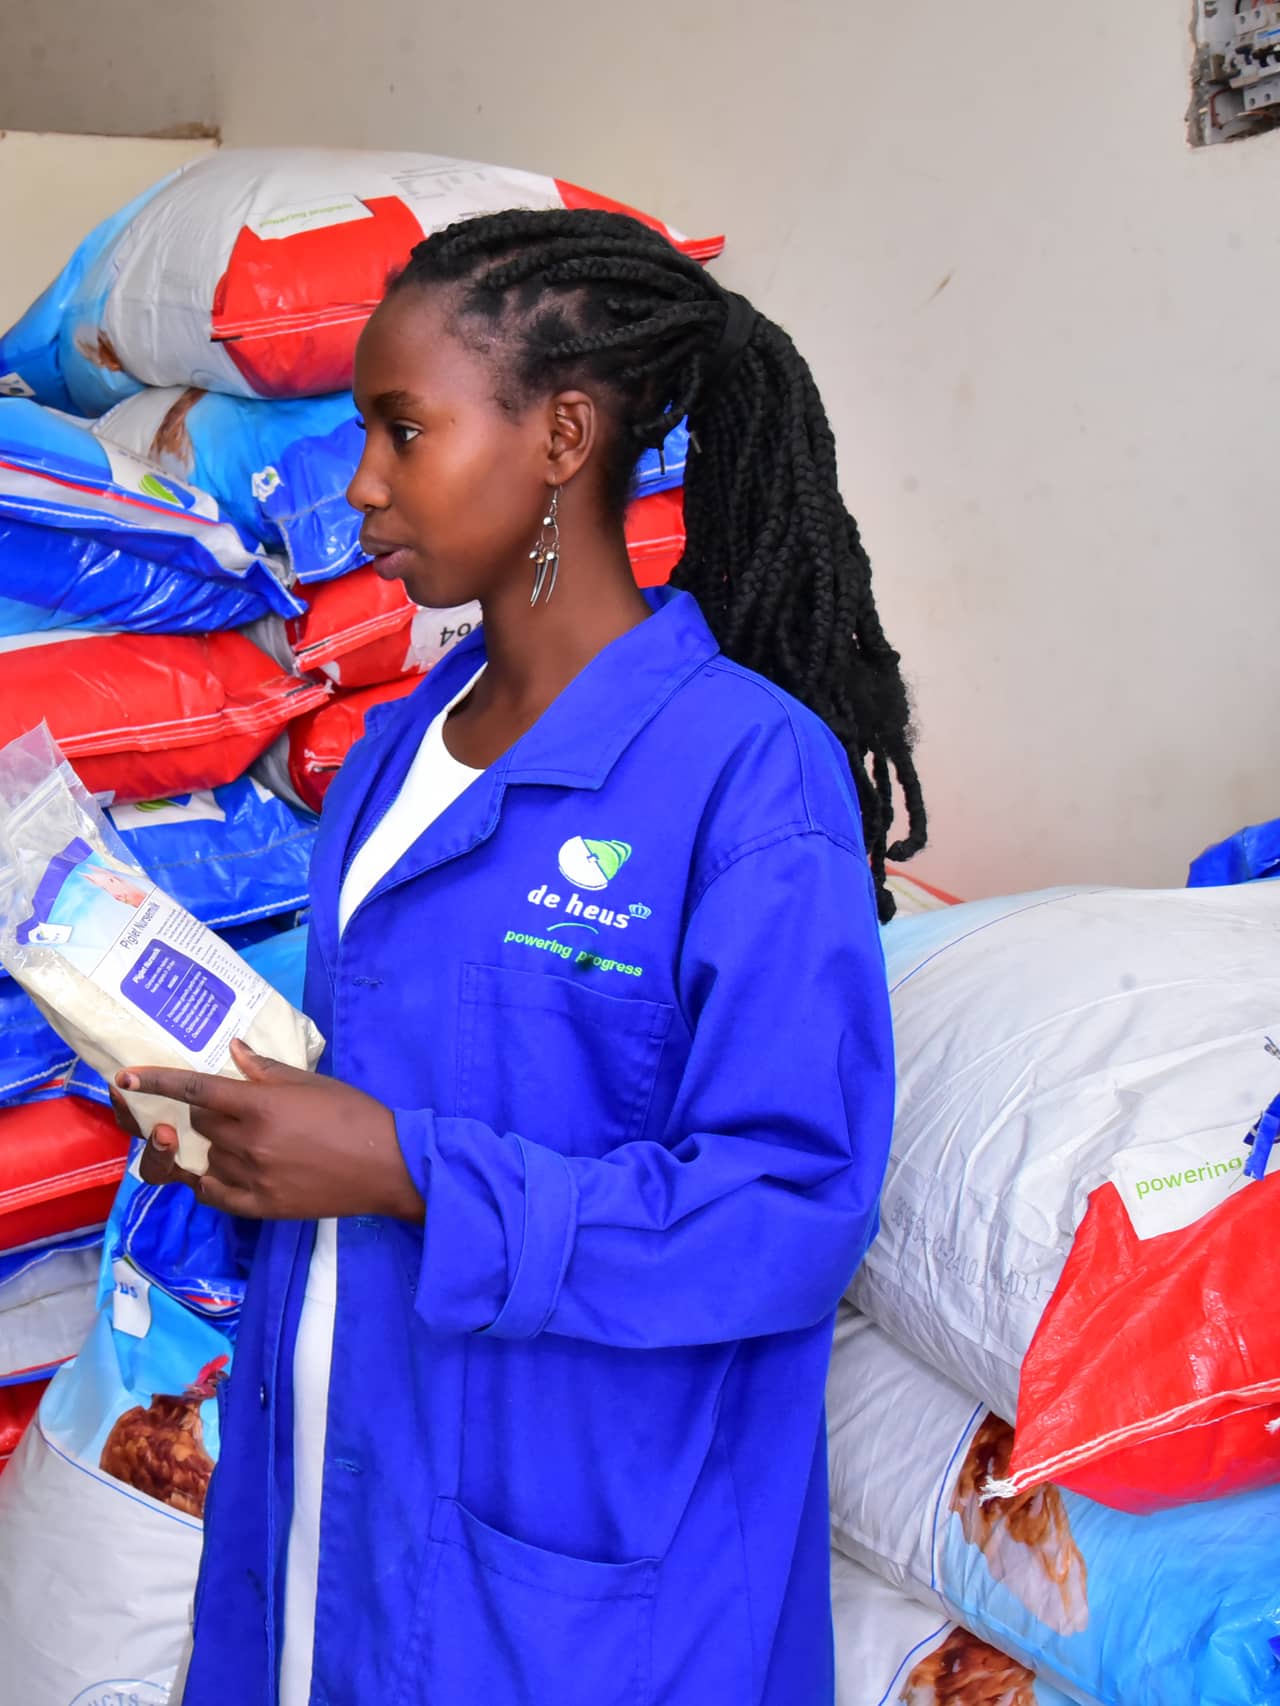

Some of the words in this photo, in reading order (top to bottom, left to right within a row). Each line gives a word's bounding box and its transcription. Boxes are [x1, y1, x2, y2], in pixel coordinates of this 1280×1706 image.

[527, 884, 560, 908] de
[565, 893, 630, 929] heus
[120, 926, 141, 950] Piglet
[504, 930, 573, 959] powering
[575, 950, 643, 977] progress
[1135, 1157, 1242, 1200] powering
